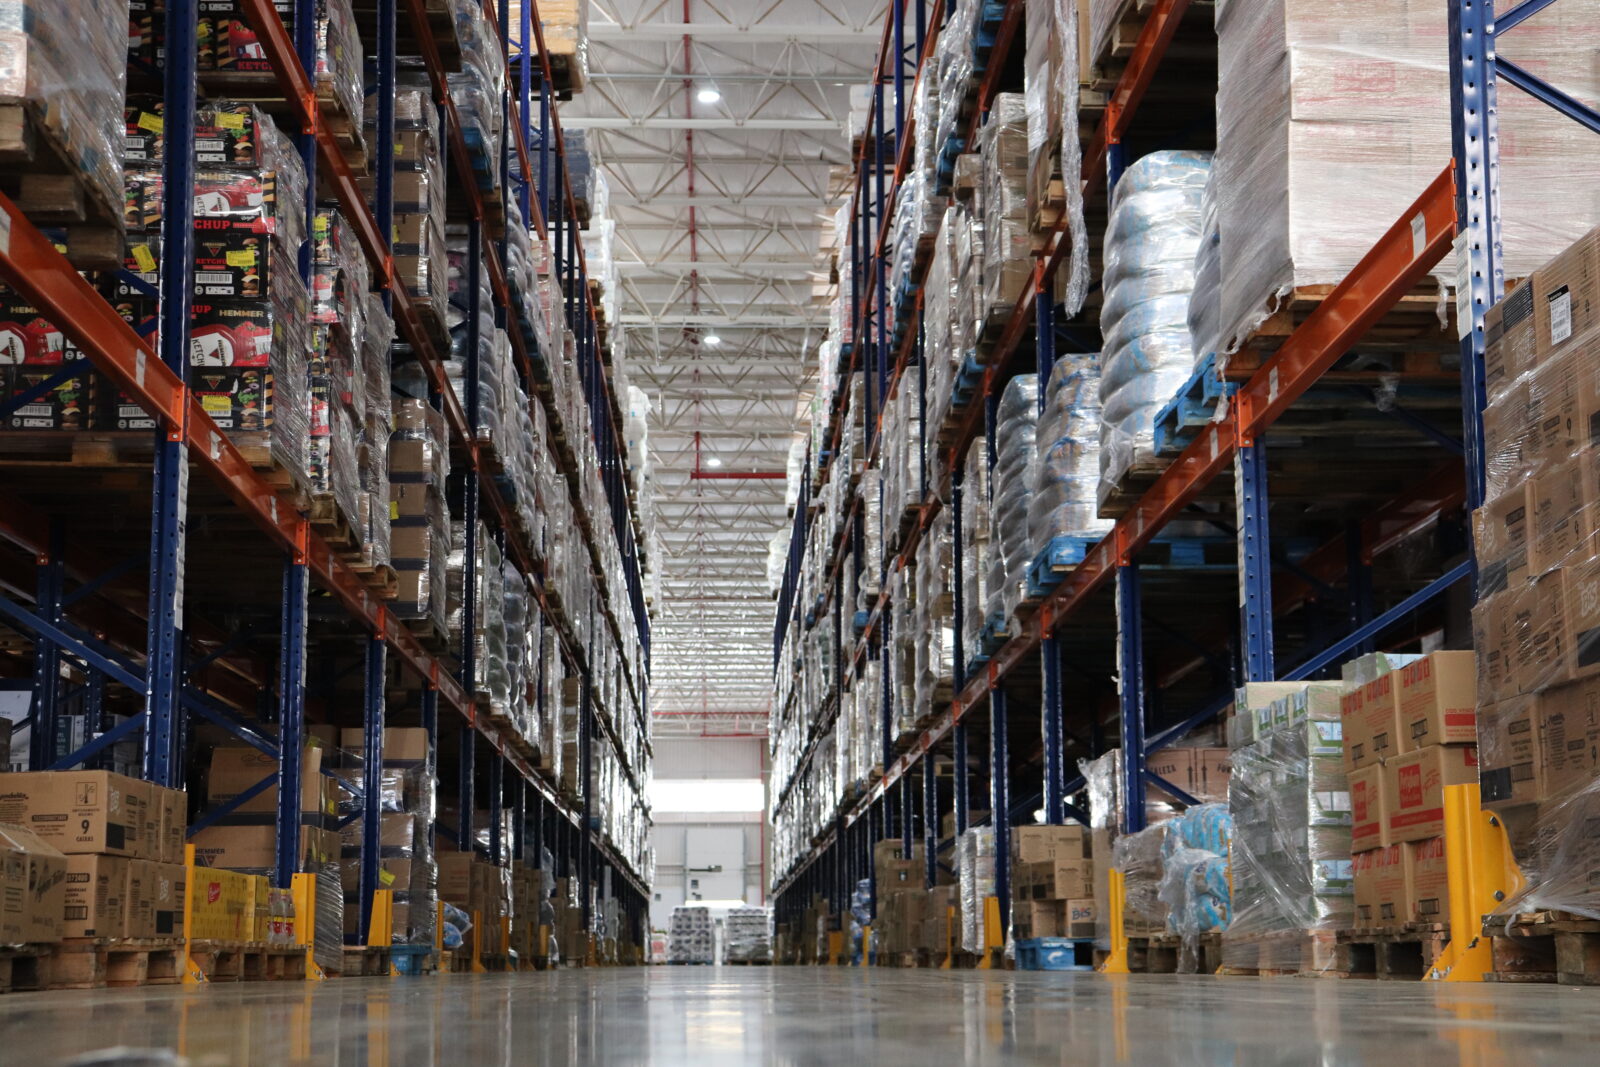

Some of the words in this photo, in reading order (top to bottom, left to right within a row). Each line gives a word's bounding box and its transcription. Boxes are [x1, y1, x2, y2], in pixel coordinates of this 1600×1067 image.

[193, 220, 231, 230] CHUP
[219, 310, 264, 319] HEMMER
[81, 820, 90, 834] 9
